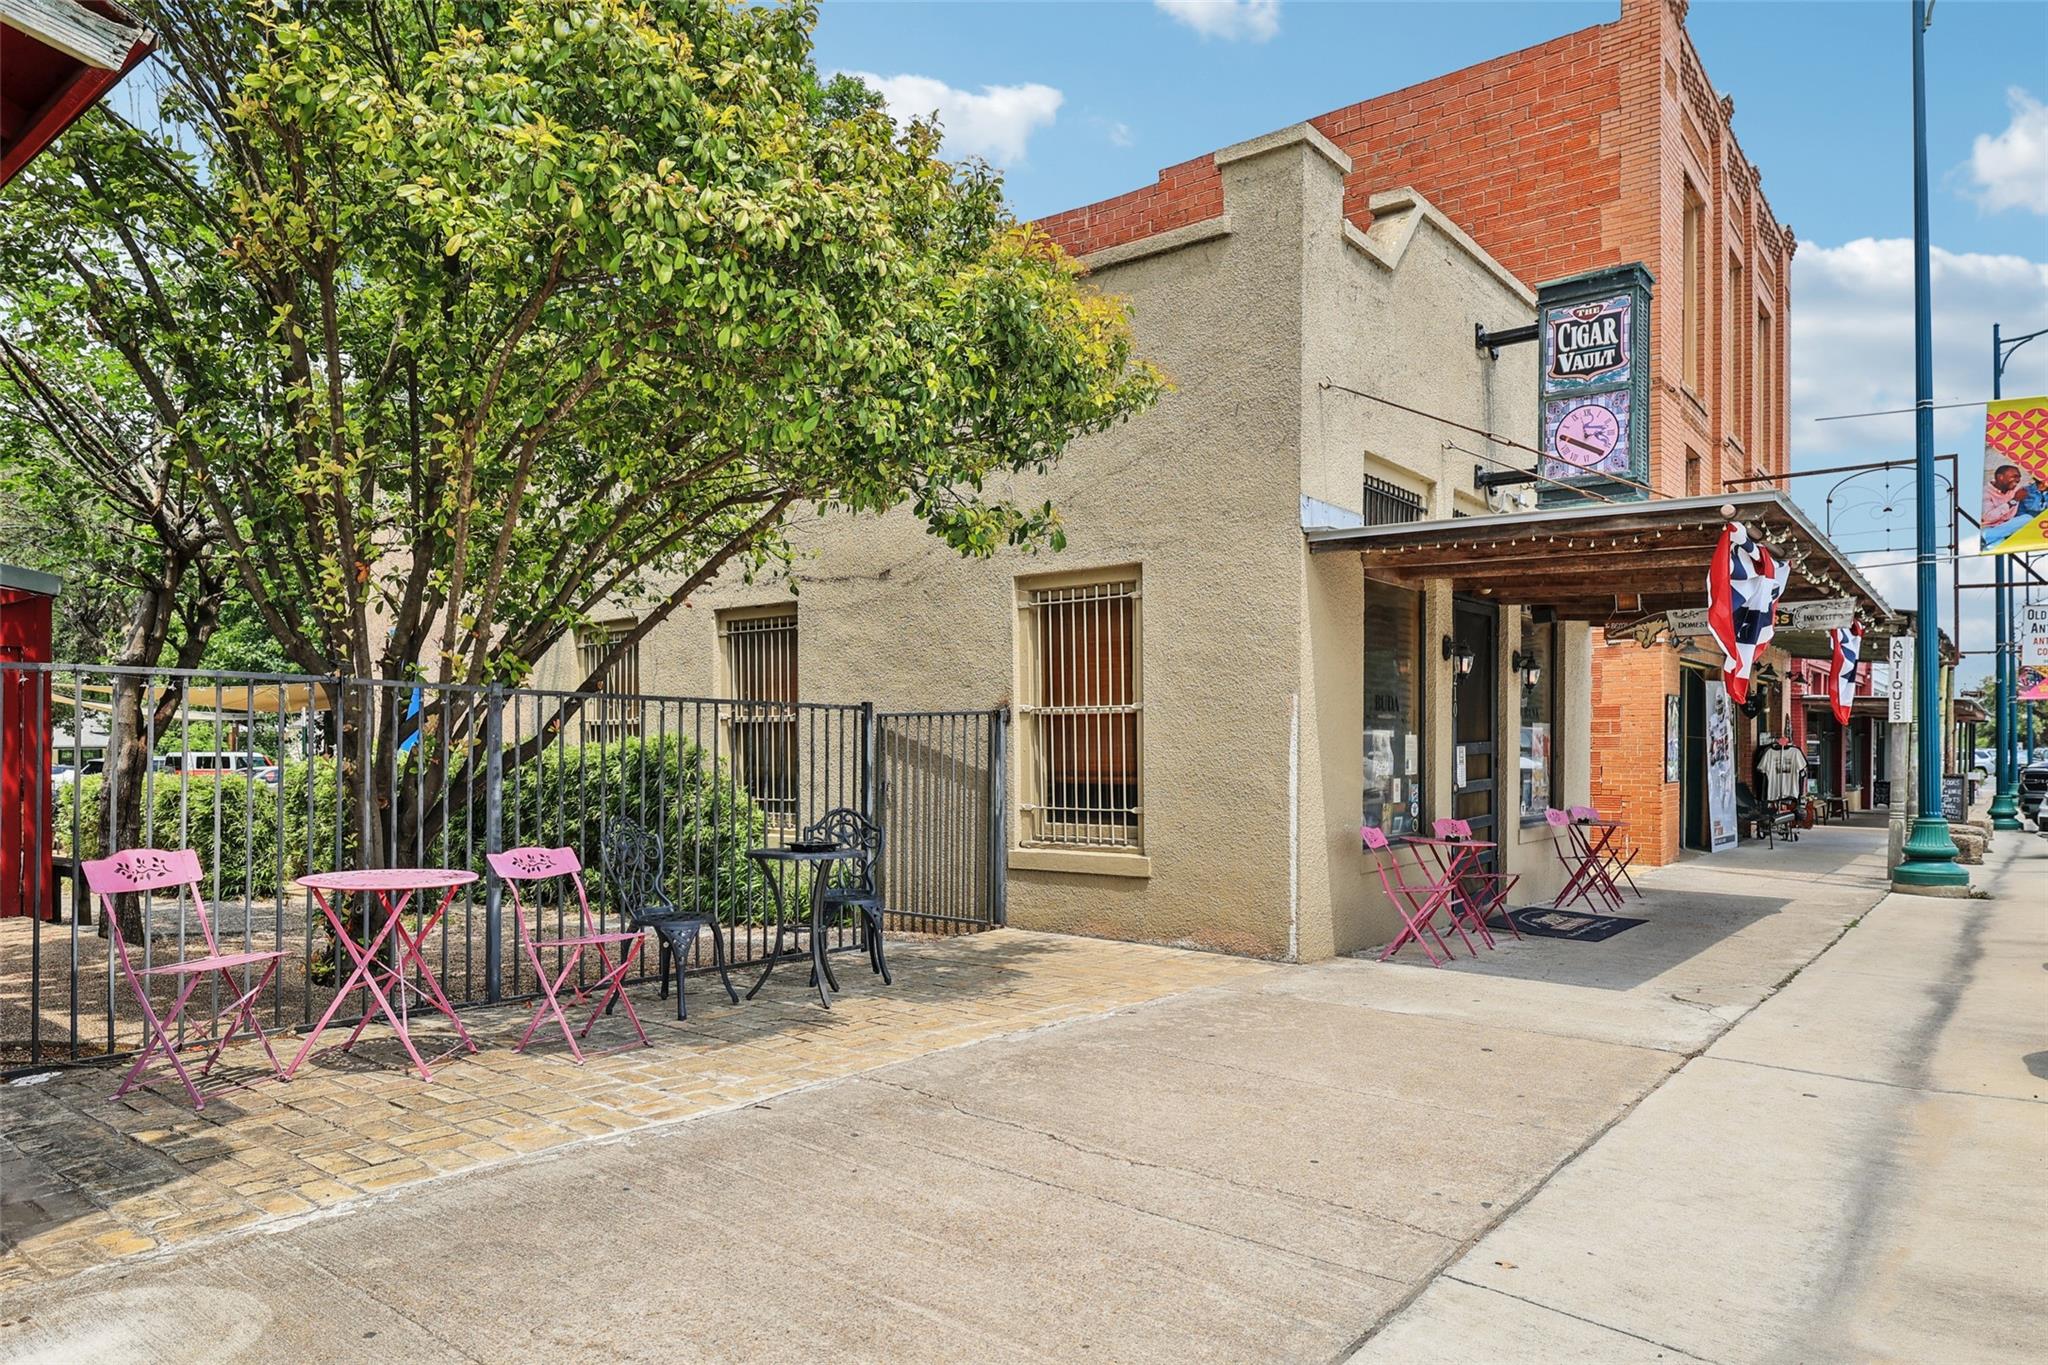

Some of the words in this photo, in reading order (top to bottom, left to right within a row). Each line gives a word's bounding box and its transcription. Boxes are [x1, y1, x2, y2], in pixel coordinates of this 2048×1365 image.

[1576, 306, 1600, 317] THE
[1557, 317, 1619, 352] CIGAR
[1557, 348, 1616, 373] VAULT
[2027, 608, 2047, 621] OLD
[2031, 622, 2048, 635] AN
[1891, 639, 1904, 721] ANTIQUES
